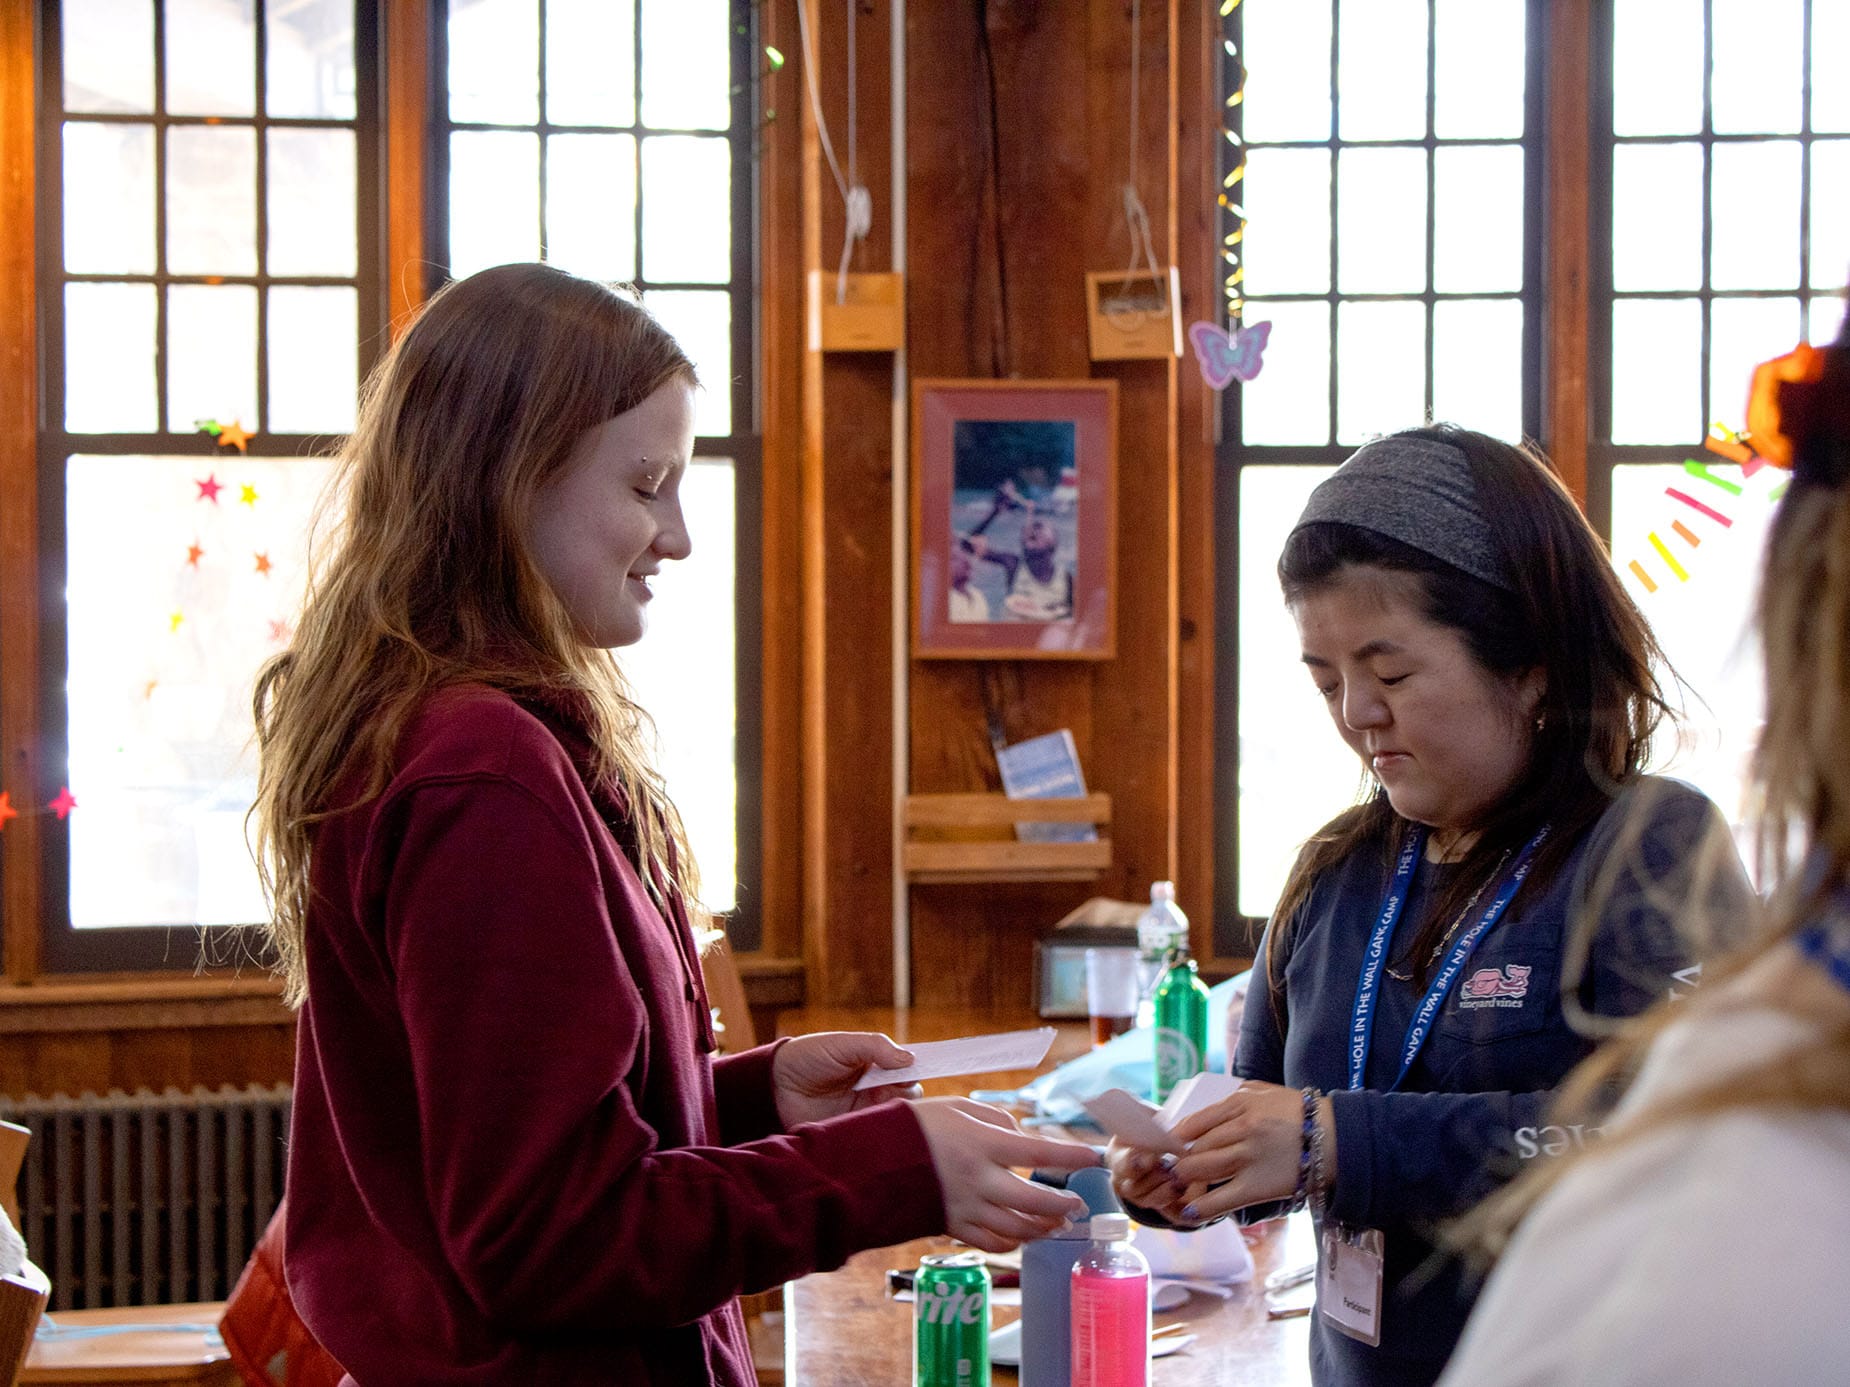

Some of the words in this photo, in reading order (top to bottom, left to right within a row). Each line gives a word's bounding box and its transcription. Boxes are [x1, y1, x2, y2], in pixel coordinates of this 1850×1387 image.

[1381, 895, 1400, 925] CAMP
[1484, 899, 1506, 920] THE
[1460, 921, 1489, 948] HOLE
[1451, 948, 1467, 965] IN
[1362, 959, 1380, 991] WALL
[1436, 966, 1457, 990] THE
[1356, 992, 1372, 1016] THE
[1417, 992, 1442, 1024] WALL
[1496, 997, 1524, 1008] vines
[1354, 1017, 1367, 1033] IN
[1352, 1034, 1365, 1069] HOLE
